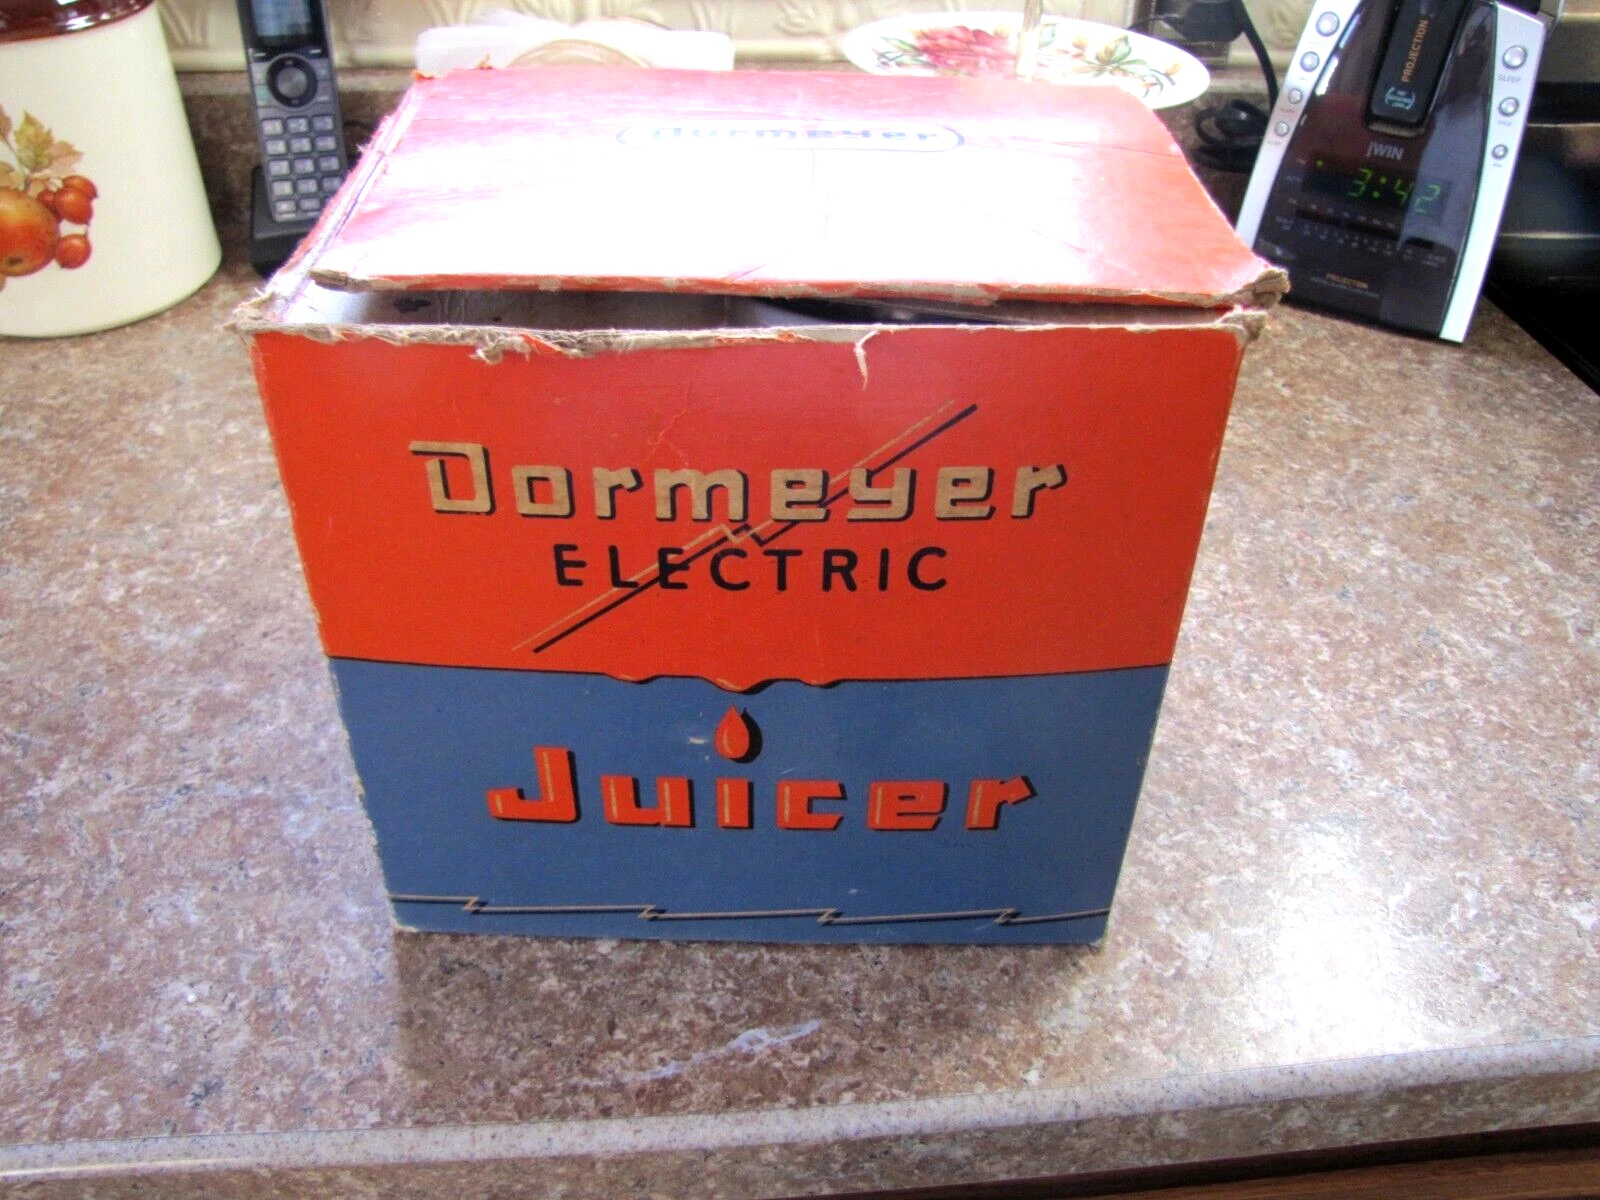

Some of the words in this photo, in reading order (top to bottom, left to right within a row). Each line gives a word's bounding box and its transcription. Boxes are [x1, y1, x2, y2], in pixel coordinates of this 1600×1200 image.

[1401, 19, 1429, 83] PROJECTION
[1348, 167, 1442, 215] 3:42
[409, 440, 1067, 522] Dormeyer
[553, 543, 948, 592] ELECTRIC
[486, 704, 1037, 830] Juicer
